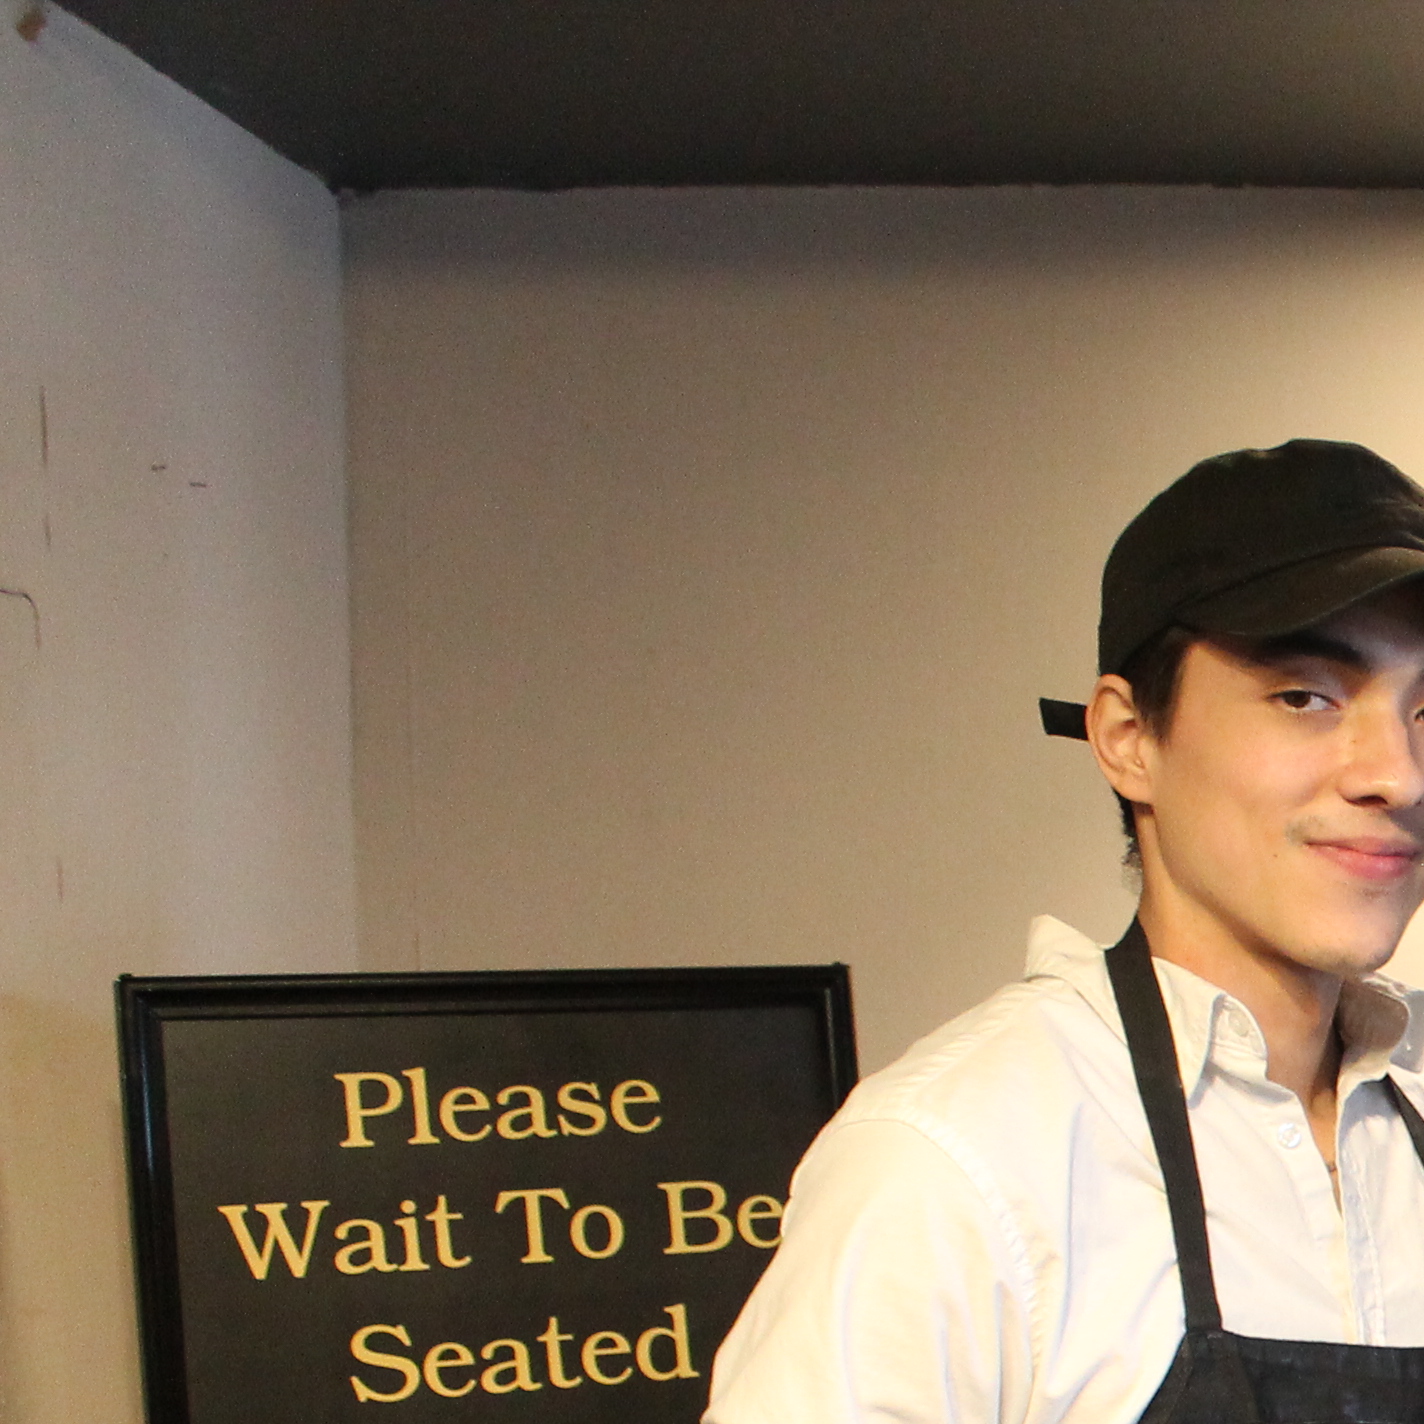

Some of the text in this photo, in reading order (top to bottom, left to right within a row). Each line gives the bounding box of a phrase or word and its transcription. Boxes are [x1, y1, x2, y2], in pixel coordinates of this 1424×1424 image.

[333, 1066, 662, 1148] Please
[217, 1179, 784, 1280] Wait To Be
[349, 1303, 700, 1403] Seated
